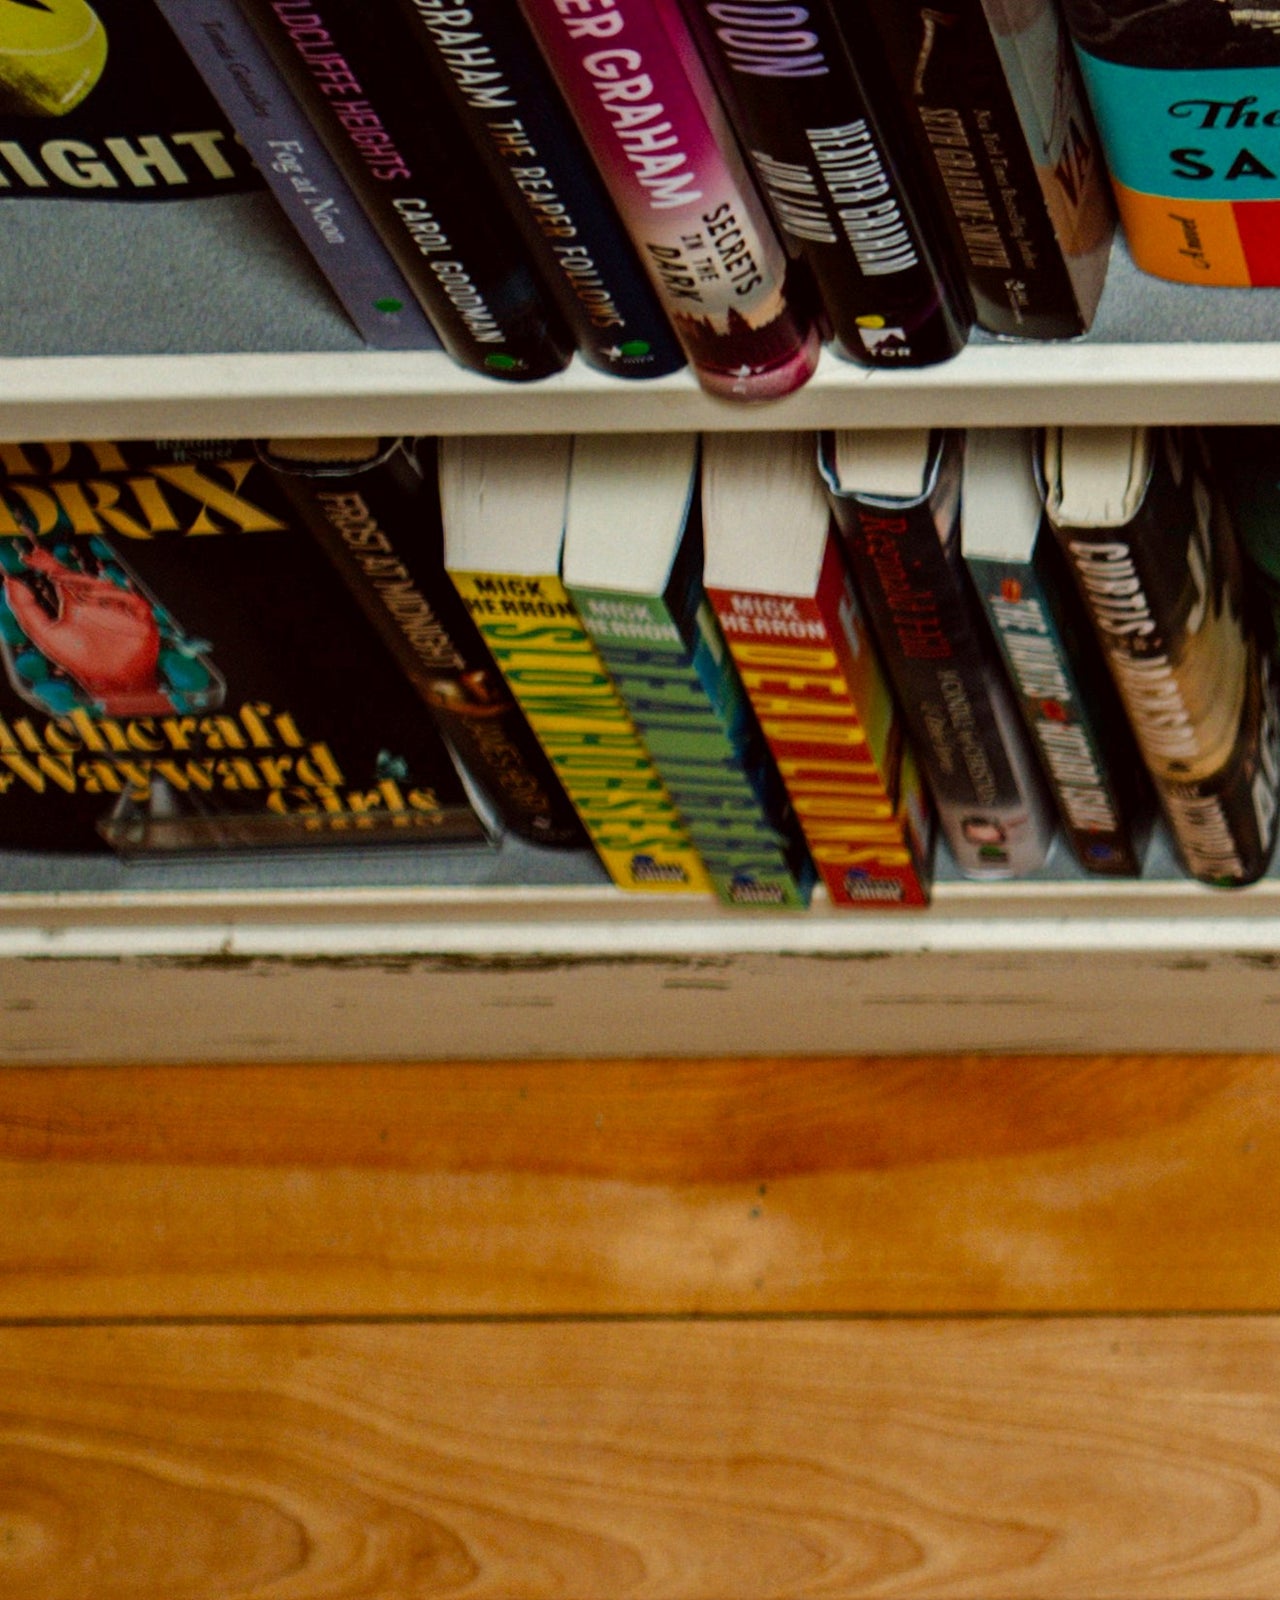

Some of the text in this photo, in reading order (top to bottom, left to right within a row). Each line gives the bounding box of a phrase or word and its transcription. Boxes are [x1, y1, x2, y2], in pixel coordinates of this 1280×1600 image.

[272, 0, 411, 180] LDCLIFFE HEIGHTS
[581, 48, 703, 210] GRAHAM
[0, 130, 256, 188] IGHT
[267, 140, 346, 244] Fog at Noon
[805, 118, 918, 276] HEATHER GRAHAM
[488, 118, 625, 328] THE REAPER FOLLOWS
[702, 203, 763, 296] SECRETS
[392, 197, 505, 343] CAROL GOODMAN
[646, 243, 703, 303] DARK
[692, 257, 720, 283] THE
[0, 458, 290, 540] DRIX
[473, 578, 546, 597] MICK
[720, 614, 826, 638] HERRON
[730, 595, 799, 614] MICK
[730, 642, 865, 743] DEAD
[2, 743, 344, 800] Wayward
[779, 760, 910, 865] LIONS
